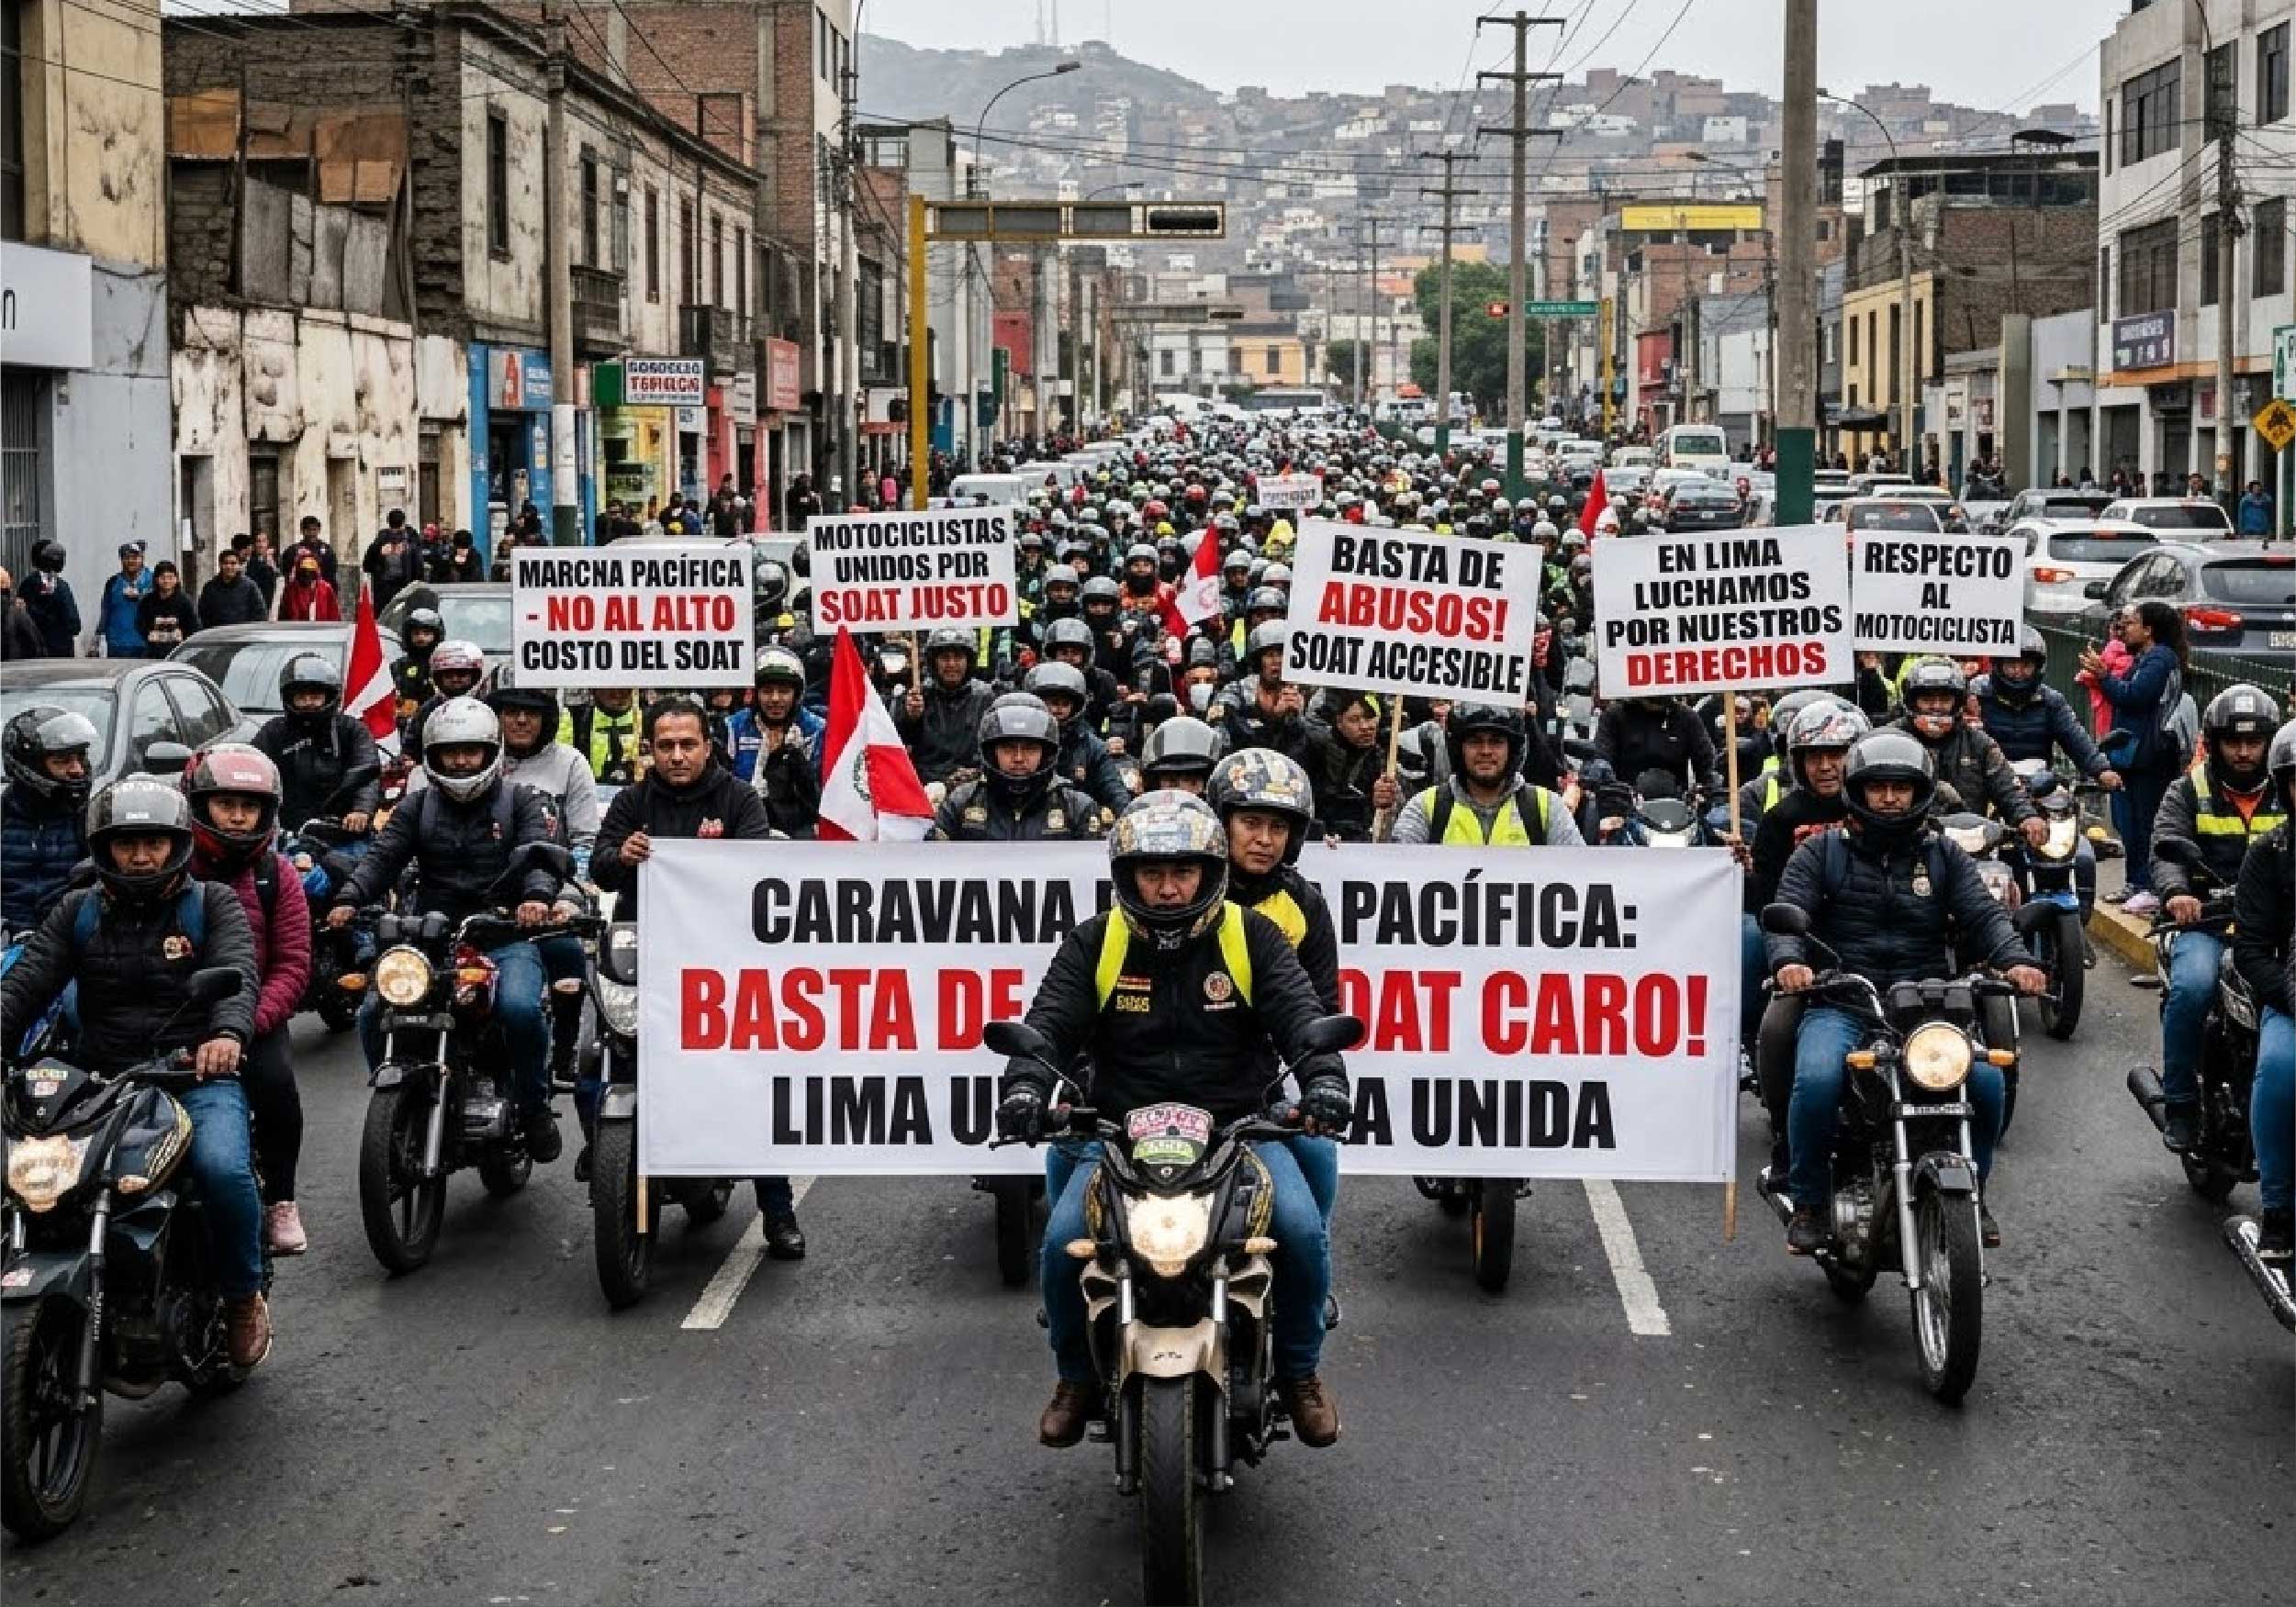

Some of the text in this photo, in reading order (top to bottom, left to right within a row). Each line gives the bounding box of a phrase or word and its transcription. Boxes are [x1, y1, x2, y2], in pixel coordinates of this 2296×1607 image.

[814, 517, 1006, 551] MOTOCICLISTAS
[519, 553, 745, 588] MARCHA PACÍFICA
[834, 552, 932, 583] UNIDOS
[1331, 535, 1505, 590] BASTA DE
[1658, 538, 1783, 573] EN LIMA
[1865, 542, 2012, 580] RESPECTO
[820, 584, 1008, 624] SOAT JUSTO
[1633, 571, 1810, 610] LUCHAMOS
[1921, 581, 1951, 609] AL
[526, 595, 735, 631] - NO AL ALTO
[1318, 581, 1508, 642] ABUSOS!
[1606, 605, 1842, 648] POR NUESTROS
[1854, 613, 2014, 643] MOTOCICLISTA
[521, 640, 745, 670] COSTO DEL SOAT
[1289, 631, 1364, 675] SOAT
[1368, 641, 1524, 693] ACCESIBLE
[1626, 642, 1827, 686] DERECHOS
[751, 877, 1075, 944] CARAVANA
[1341, 868, 1637, 948] PACÍFICA:
[679, 966, 918, 1052] BASTA
[1482, 970, 1708, 1057] CARO!
[773, 1077, 933, 1145] LIMA
[1411, 1077, 1617, 1149] UNIDA
